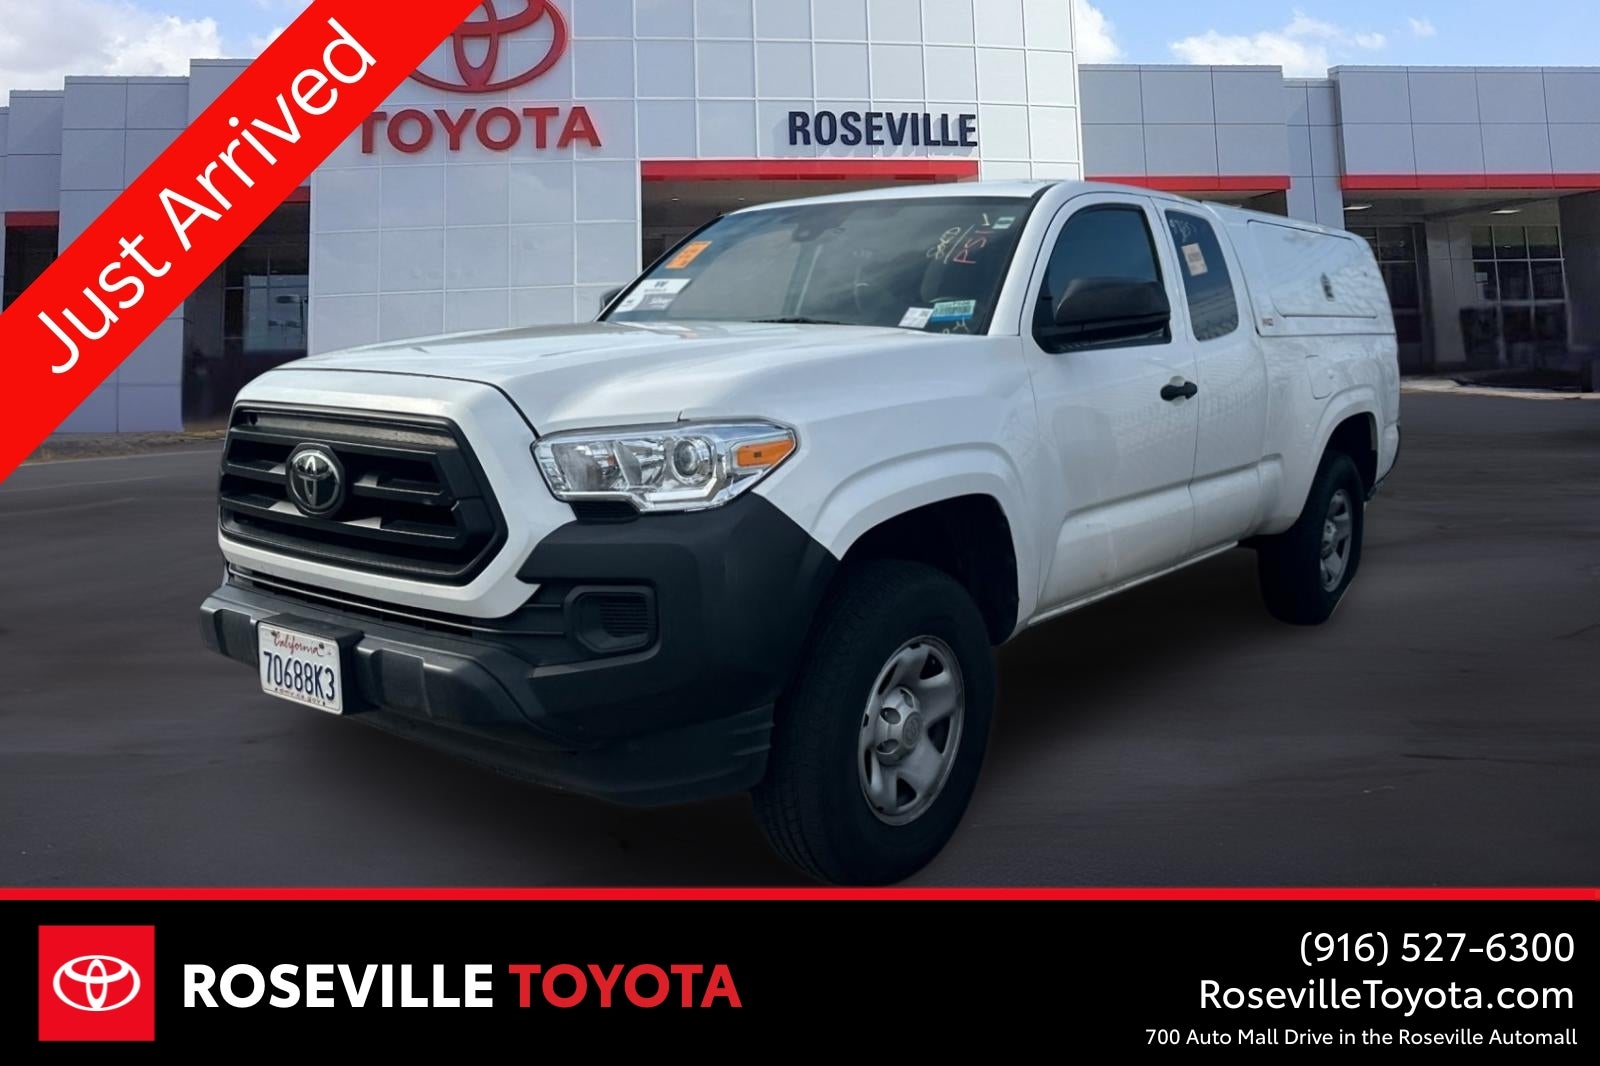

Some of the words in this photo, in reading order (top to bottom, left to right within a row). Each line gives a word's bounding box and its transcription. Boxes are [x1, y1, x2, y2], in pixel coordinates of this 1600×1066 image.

[361, 106, 602, 154] TOYOTA
[788, 110, 978, 147] ROSEVILLE
[273, 632, 324, 657] California
[263, 650, 335, 701] 70688K3
